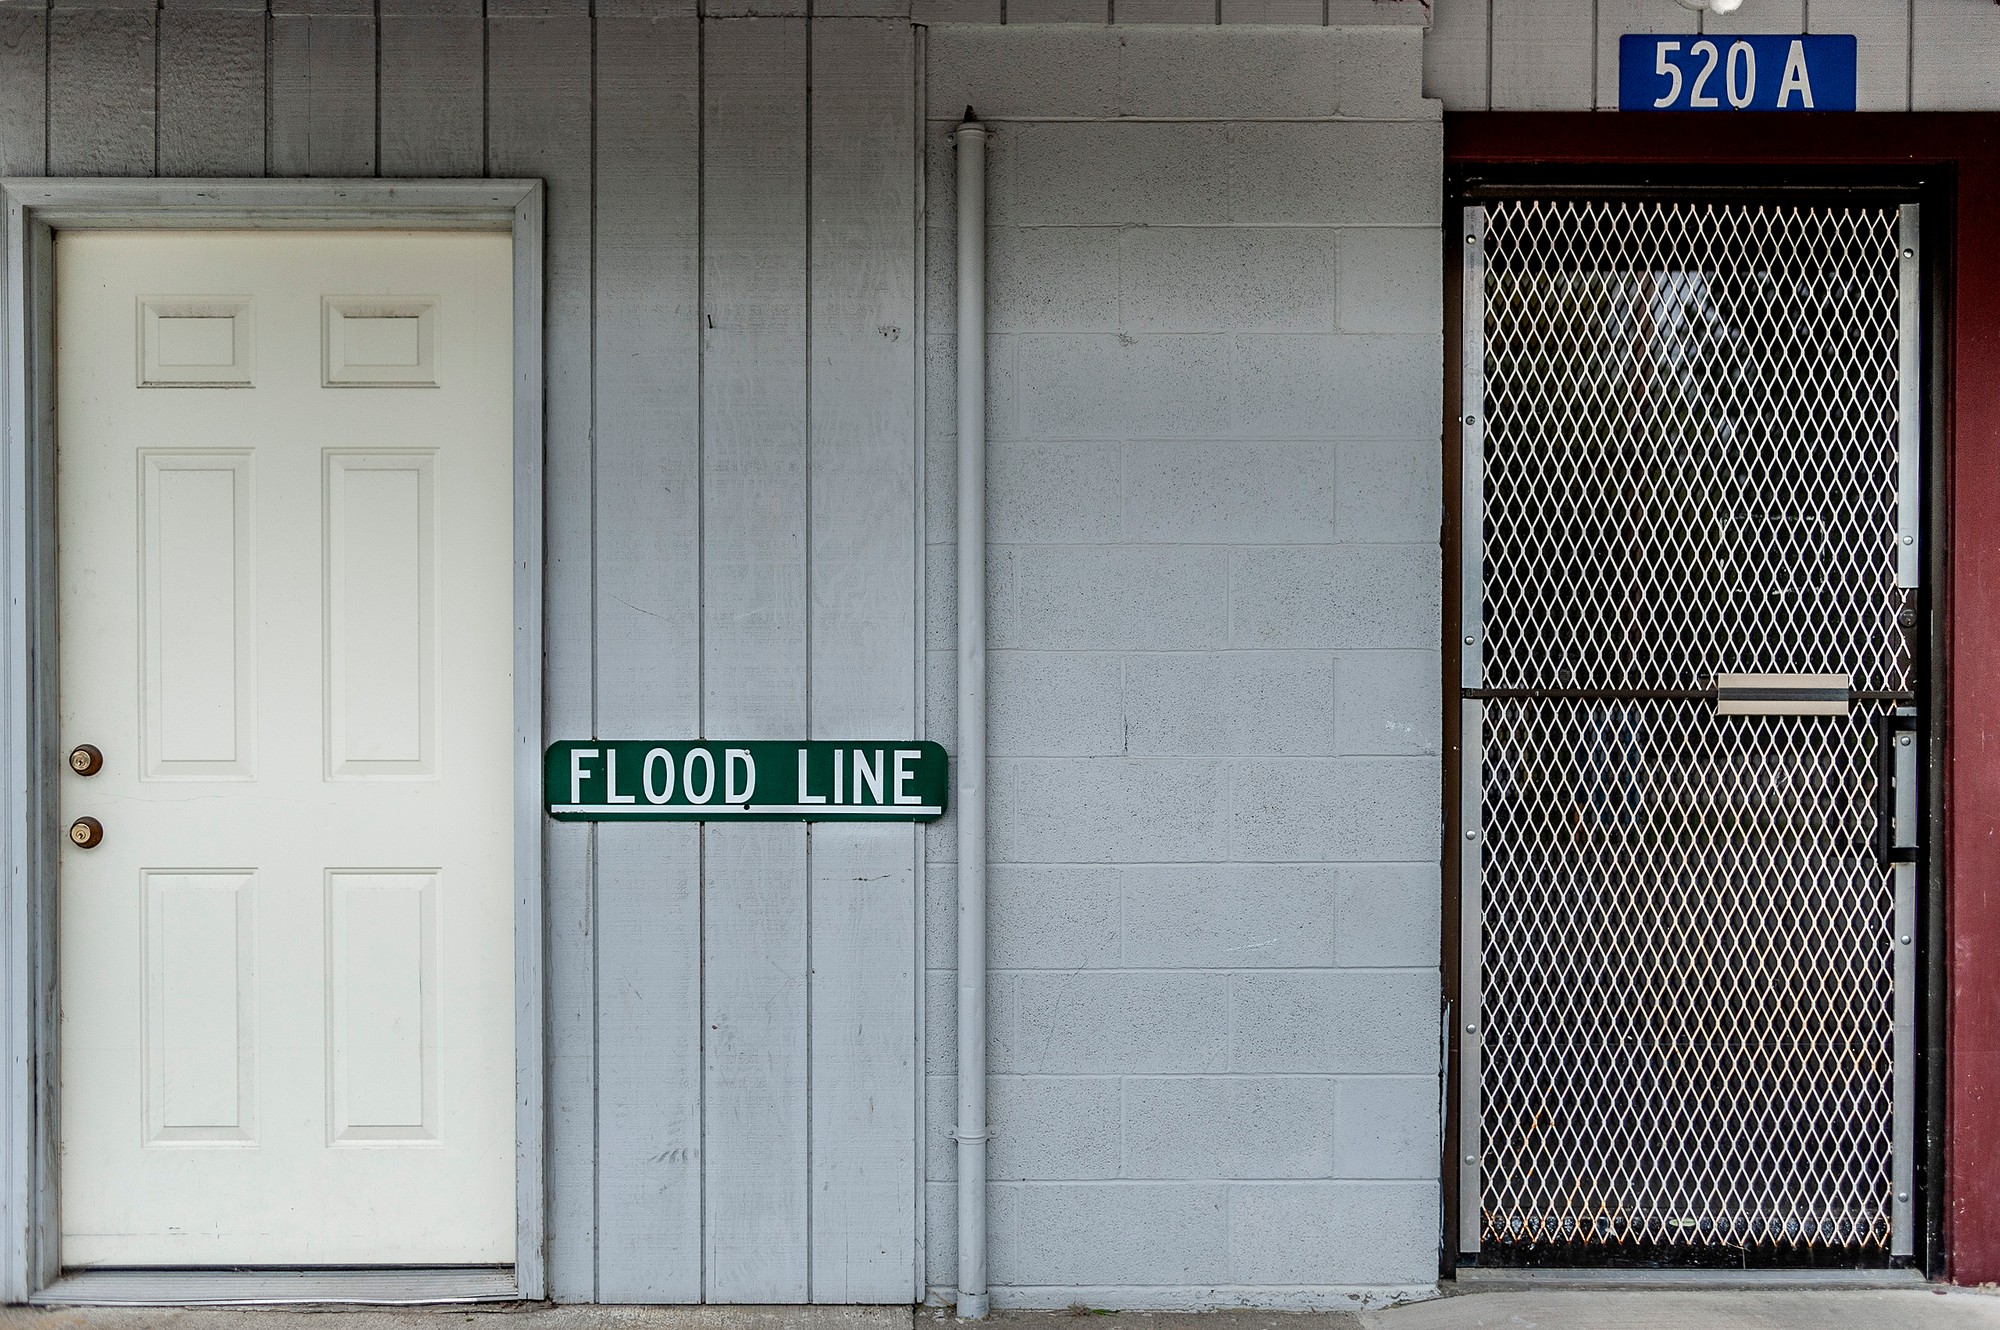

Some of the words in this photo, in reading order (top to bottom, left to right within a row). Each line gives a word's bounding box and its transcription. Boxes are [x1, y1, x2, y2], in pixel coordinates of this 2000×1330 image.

[1653, 40, 1756, 109] 520
[1776, 40, 1814, 108] A
[570, 747, 756, 805] FLOOD
[798, 749, 922, 805] LINE
